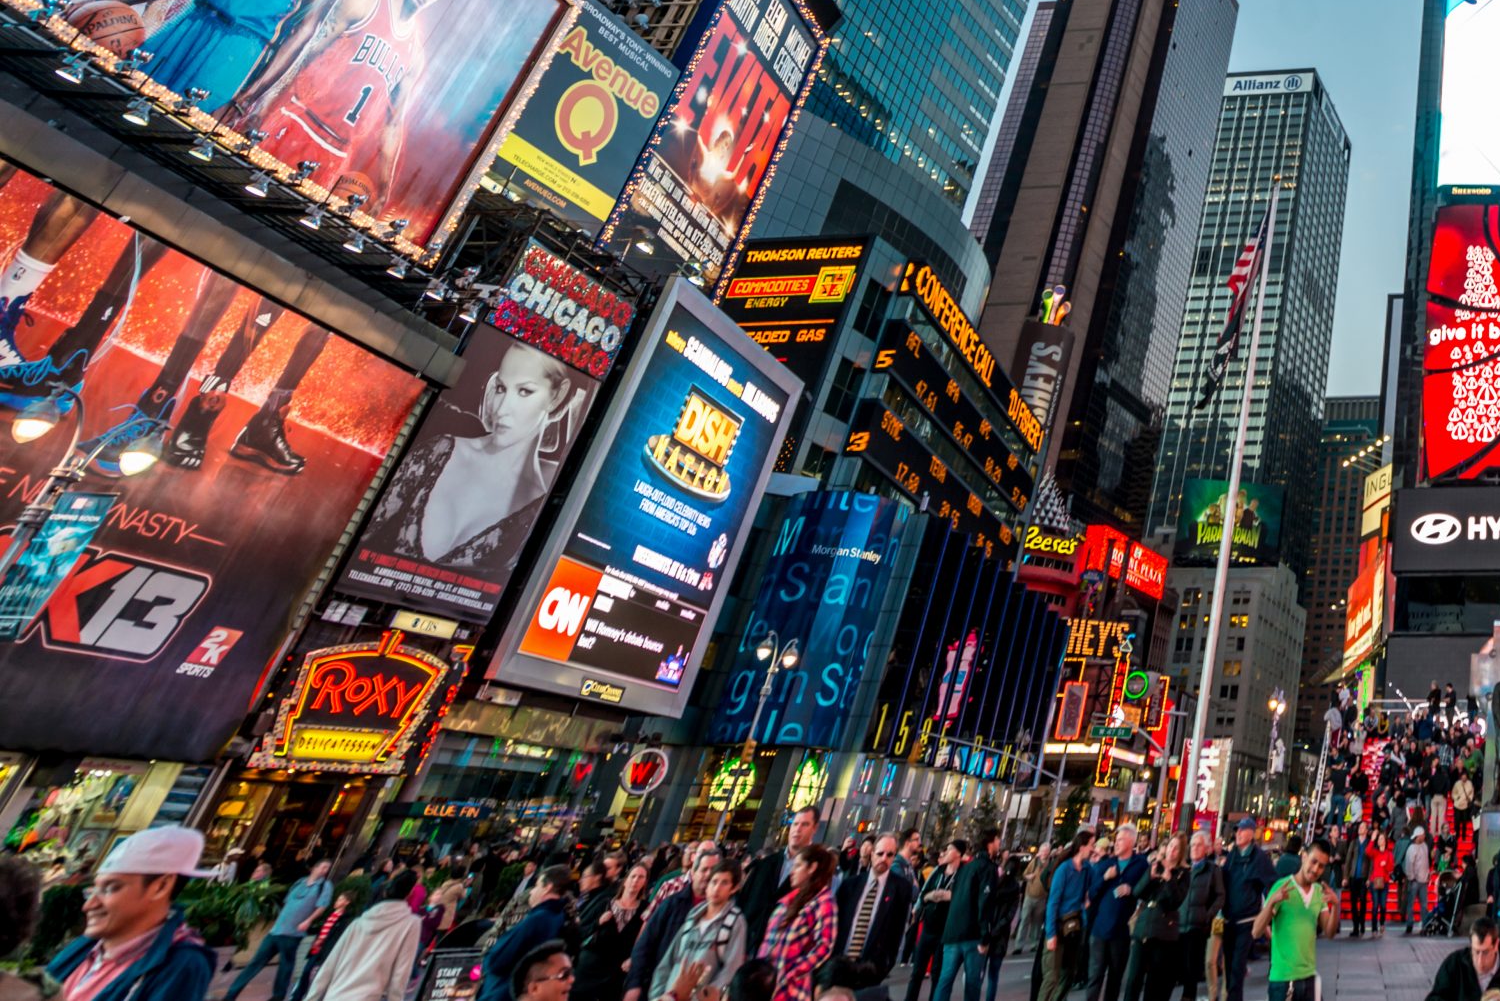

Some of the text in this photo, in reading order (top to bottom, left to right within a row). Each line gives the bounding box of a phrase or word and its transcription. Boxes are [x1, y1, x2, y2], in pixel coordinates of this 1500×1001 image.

[598, 25, 649, 72] BEST MUSICAL
[559, 26, 660, 119] Avenue
[1232, 77, 1282, 92] Allianz
[344, 84, 373, 127] 1
[674, 11, 792, 199] EVITA
[555, 79, 618, 166] Q
[1451, 186, 1492, 197] SHERWOOD
[746, 245, 863, 264] THOMSON REUTERS
[524, 247, 633, 328] CHICAGO
[733, 278, 810, 295] COMMODITIES
[510, 272, 621, 352] CHICAGO
[744, 296, 789, 310] ENERGY
[495, 299, 610, 377] CHICAGO
[795, 328, 826, 343] GAS
[915, 265, 997, 388] CONFERENCE CALL
[1429, 323, 1468, 346] give
[1471, 322, 1486, 341] it
[875, 349, 897, 369] 5
[674, 394, 737, 465] DISH
[653, 433, 728, 495] NATION
[638, 497, 658, 517] FROM
[811, 544, 883, 566] Morgan Stanley
[1024, 525, 1078, 556] Reese's
[538, 586, 591, 637] CNN
[200, 629, 231, 665] 2K
[596, 620, 646, 647] Romney's debate
[176, 662, 215, 679] SPORTS
[310, 660, 423, 718] ROXY
[298, 735, 379, 753] DELICATESSEN
[423, 803, 481, 820] BLUE FIN
